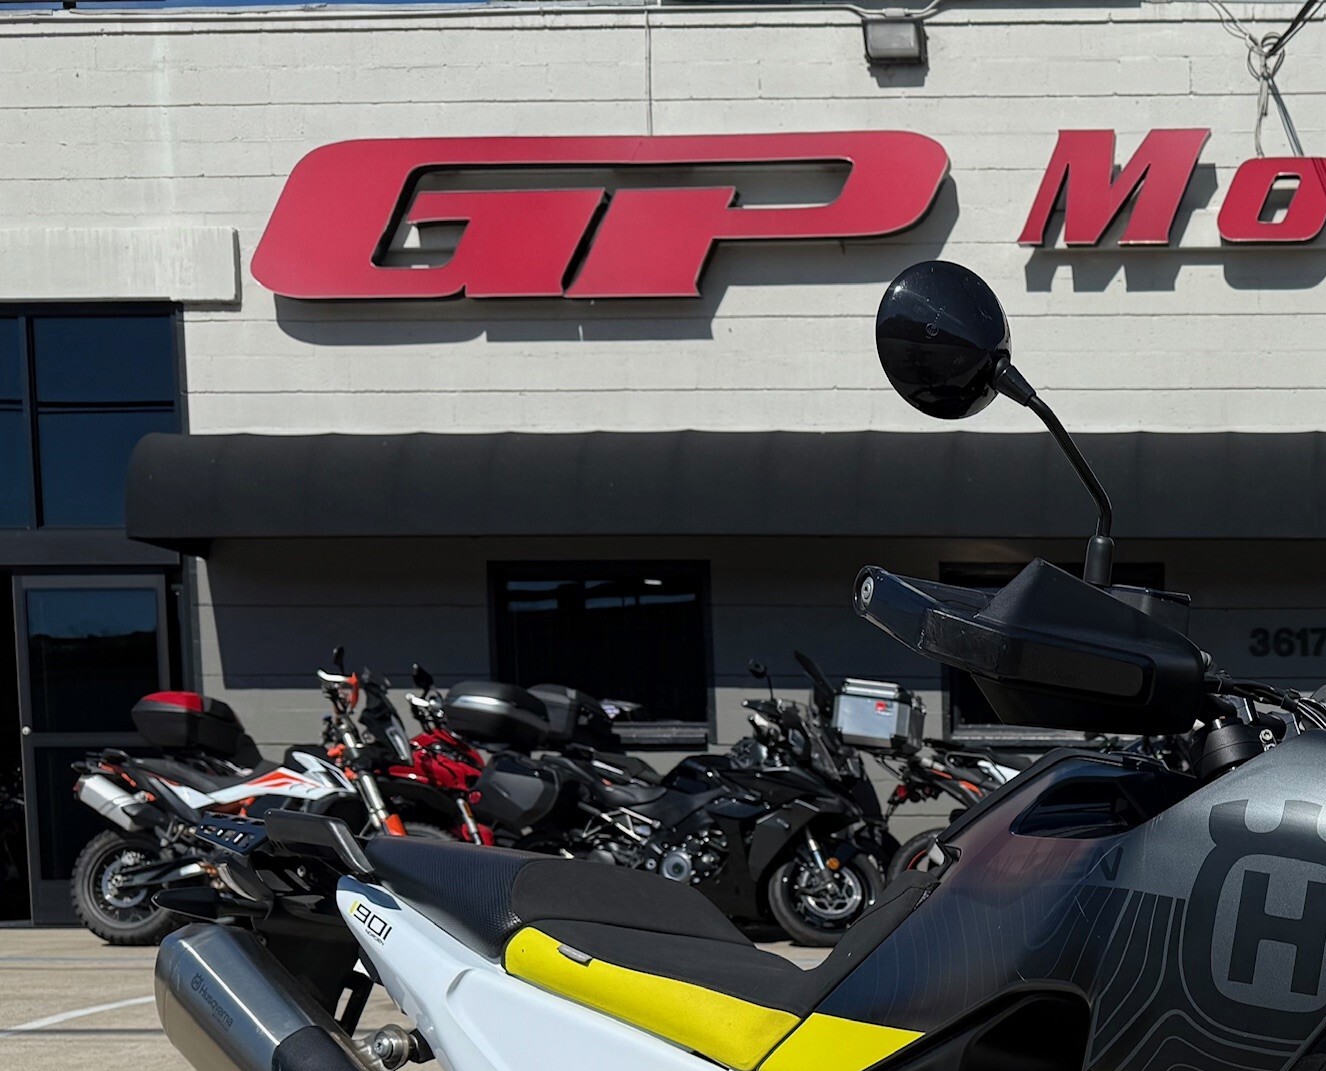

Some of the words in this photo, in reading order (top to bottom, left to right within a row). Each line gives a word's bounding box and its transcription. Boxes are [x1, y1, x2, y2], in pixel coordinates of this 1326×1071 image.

[250, 130, 951, 300] GP
[353, 903, 393, 941] 901
[198, 984, 234, 1028] Husqvarna
